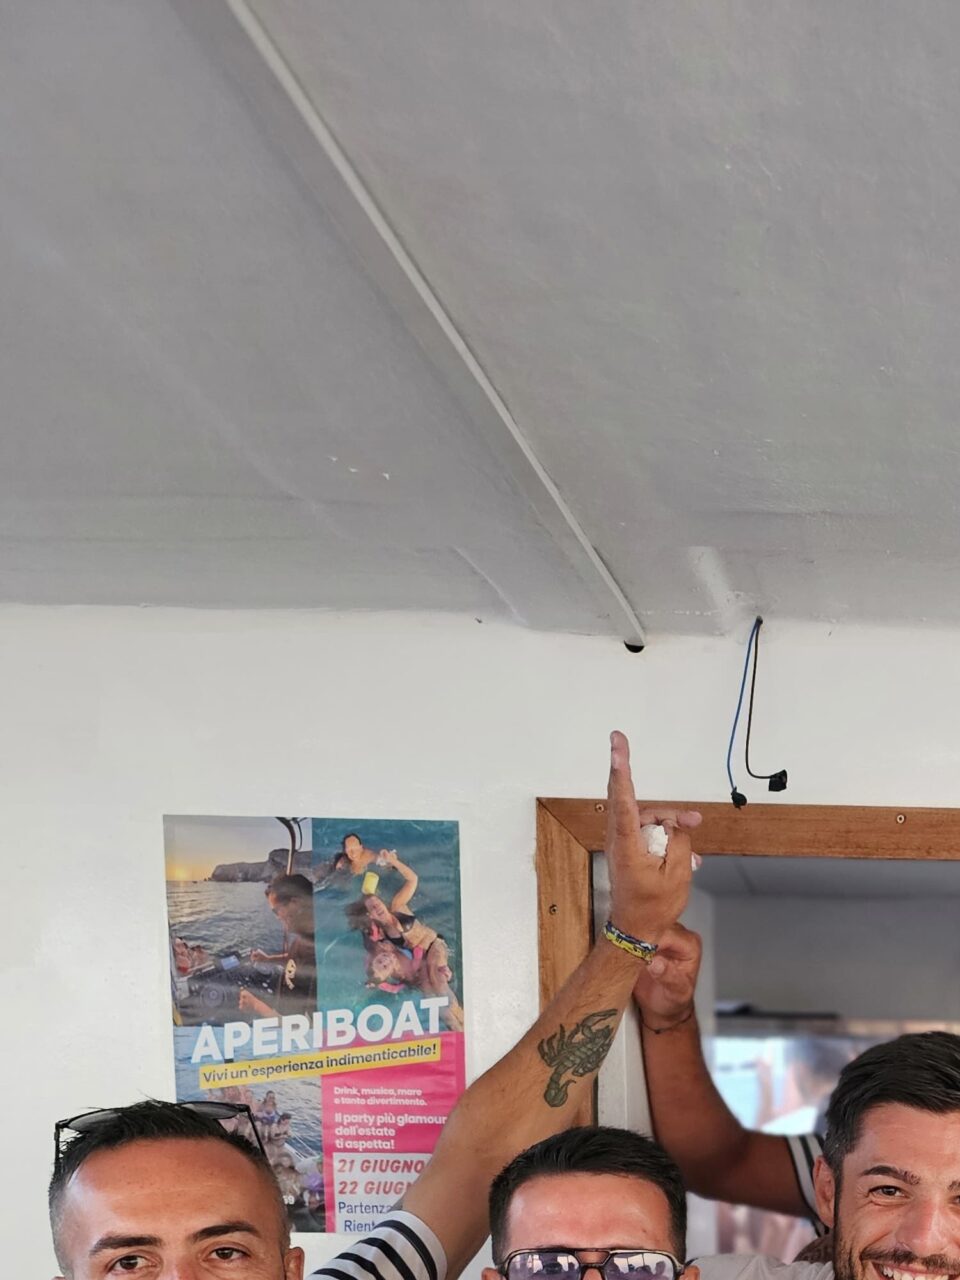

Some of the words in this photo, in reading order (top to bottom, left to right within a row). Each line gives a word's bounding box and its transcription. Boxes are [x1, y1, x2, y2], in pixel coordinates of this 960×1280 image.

[190, 996, 449, 1064] APERIBOAT
[203, 1068, 228, 1083] Vivi
[230, 1060, 324, 1079] un'esperienza
[326, 1043, 437, 1068] indimenticabile!
[333, 1086, 361, 1096] Drink,
[361, 1086, 397, 1096] musica,
[397, 1088, 423, 1096] mare
[341, 1097, 366, 1105] tanto
[366, 1096, 428, 1106] divertimento.
[334, 1112, 342, 1123] Il
[343, 1113, 375, 1126] party
[376, 1112, 396, 1126] più
[396, 1113, 448, 1127] glamour
[334, 1125, 396, 1137] dell'estate
[335, 1139, 344, 1149] ti
[345, 1139, 396, 1152] aspetta!
[337, 1158, 355, 1173] 21
[360, 1158, 426, 1174] GIUGNO
[338, 1180, 359, 1195] 22
